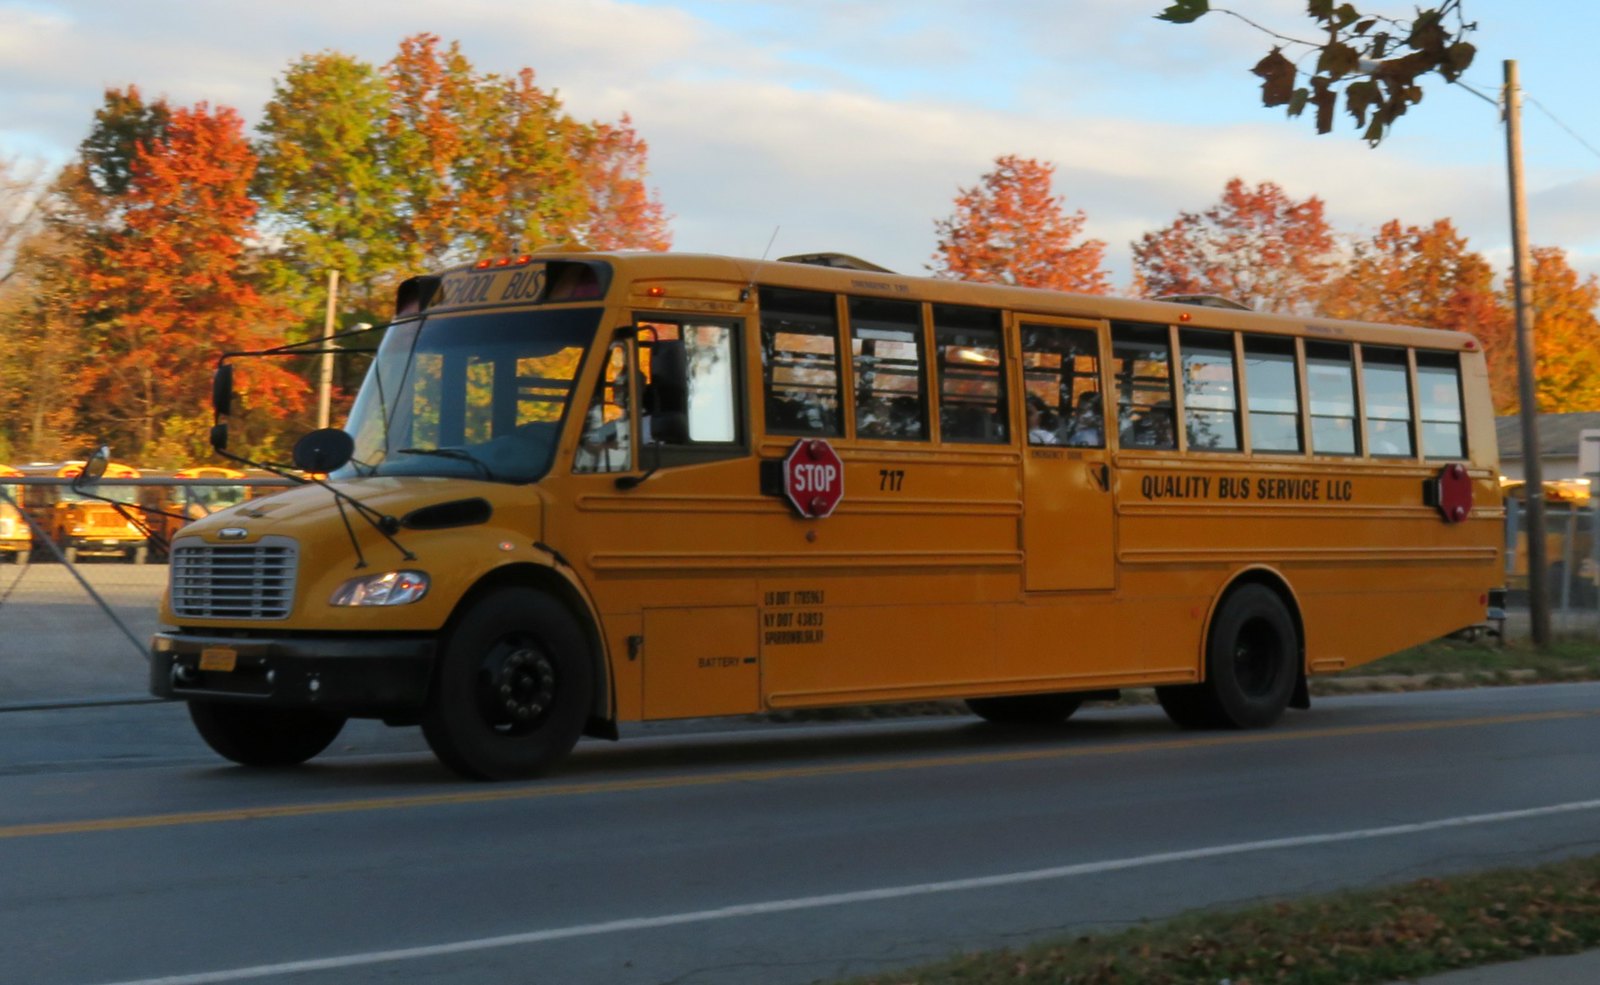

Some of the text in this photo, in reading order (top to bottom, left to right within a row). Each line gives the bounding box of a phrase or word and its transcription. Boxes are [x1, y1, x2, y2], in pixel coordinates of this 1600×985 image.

[501, 269, 546, 301] BUS
[794, 464, 836, 492] STOP
[879, 469, 904, 491] 717
[1142, 475, 1353, 501] QUALITY BUS SERVICE LLC
[776, 612, 793, 627] DOT
[698, 656, 739, 668] BATTERY
